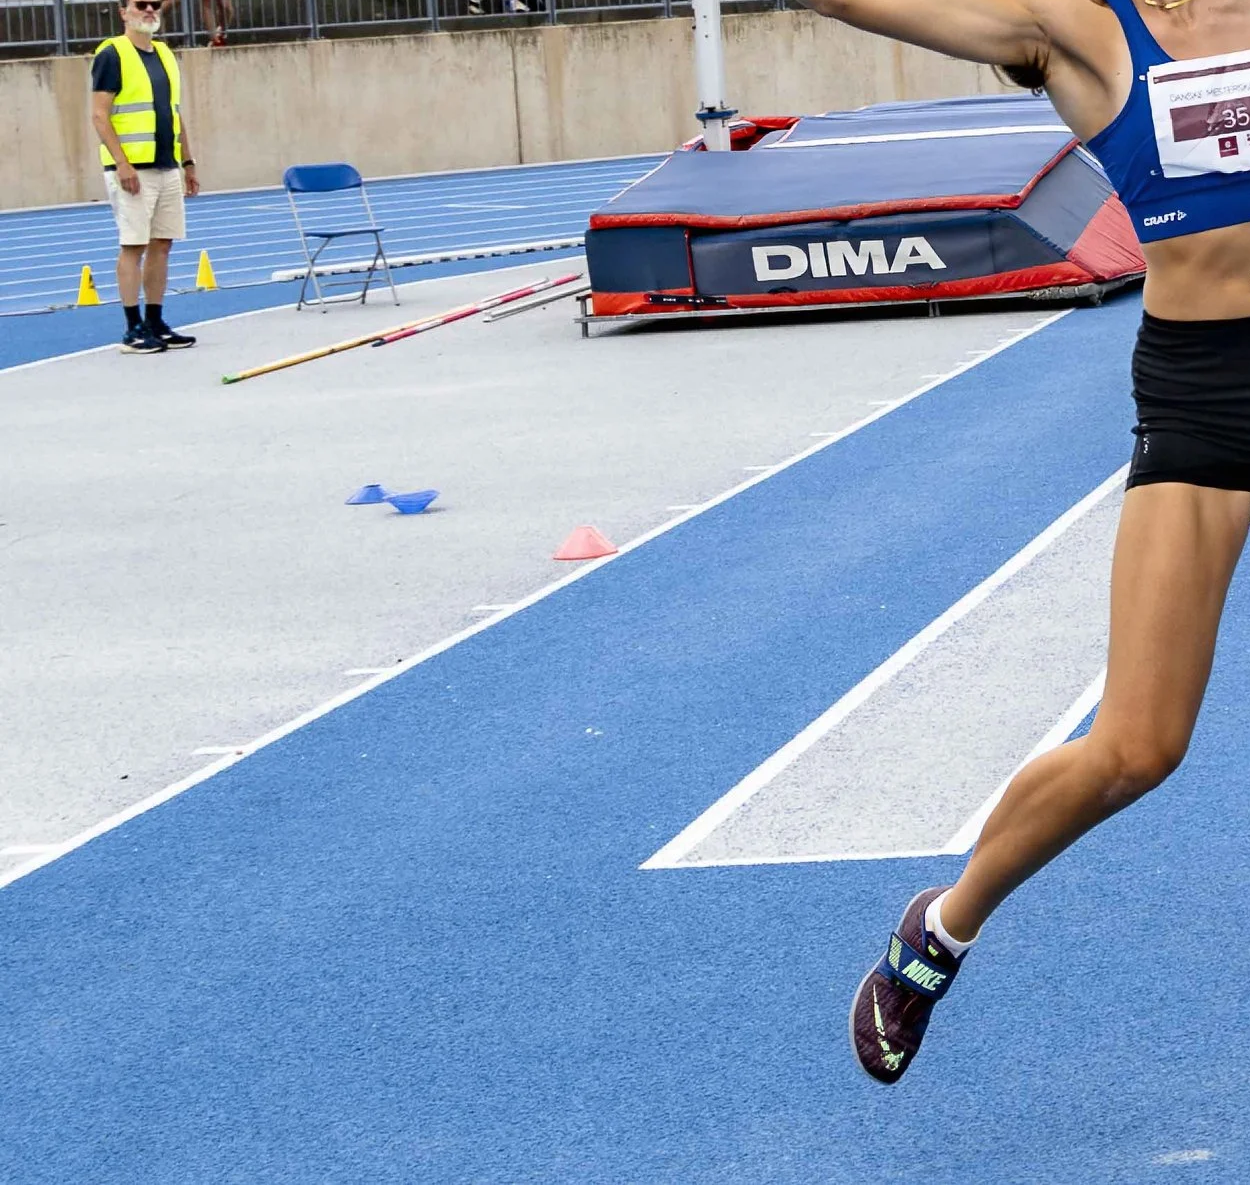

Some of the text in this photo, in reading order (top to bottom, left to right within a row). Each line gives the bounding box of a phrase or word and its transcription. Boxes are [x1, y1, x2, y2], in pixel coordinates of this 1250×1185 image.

[1222, 106, 1250, 129] 35
[1143, 212, 1177, 227] CRAFT
[751, 236, 947, 282] DIMA
[901, 959, 947, 991] NIKE
